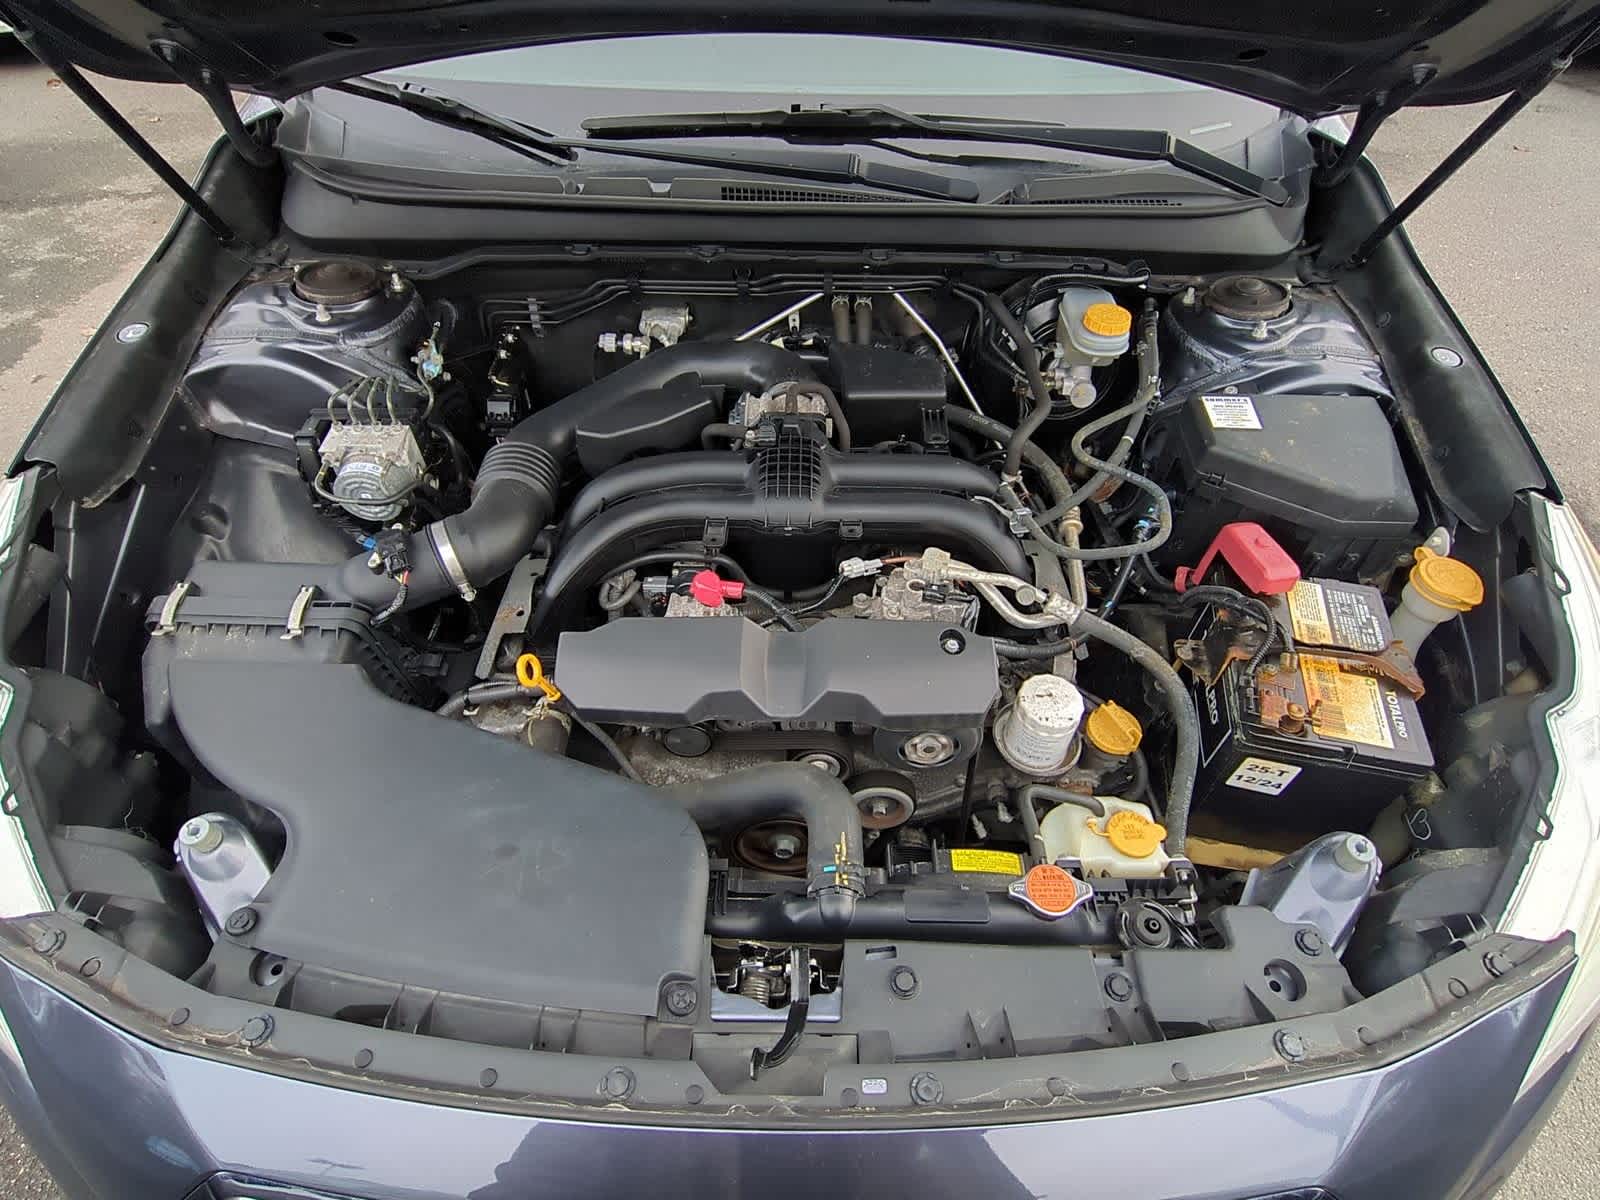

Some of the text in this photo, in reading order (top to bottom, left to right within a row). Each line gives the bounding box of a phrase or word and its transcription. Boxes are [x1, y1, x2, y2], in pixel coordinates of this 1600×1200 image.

[1385, 690, 1408, 738] TOTALPRO
[1246, 763, 1289, 777] 25-T
[1234, 774, 1283, 790] 12/24
